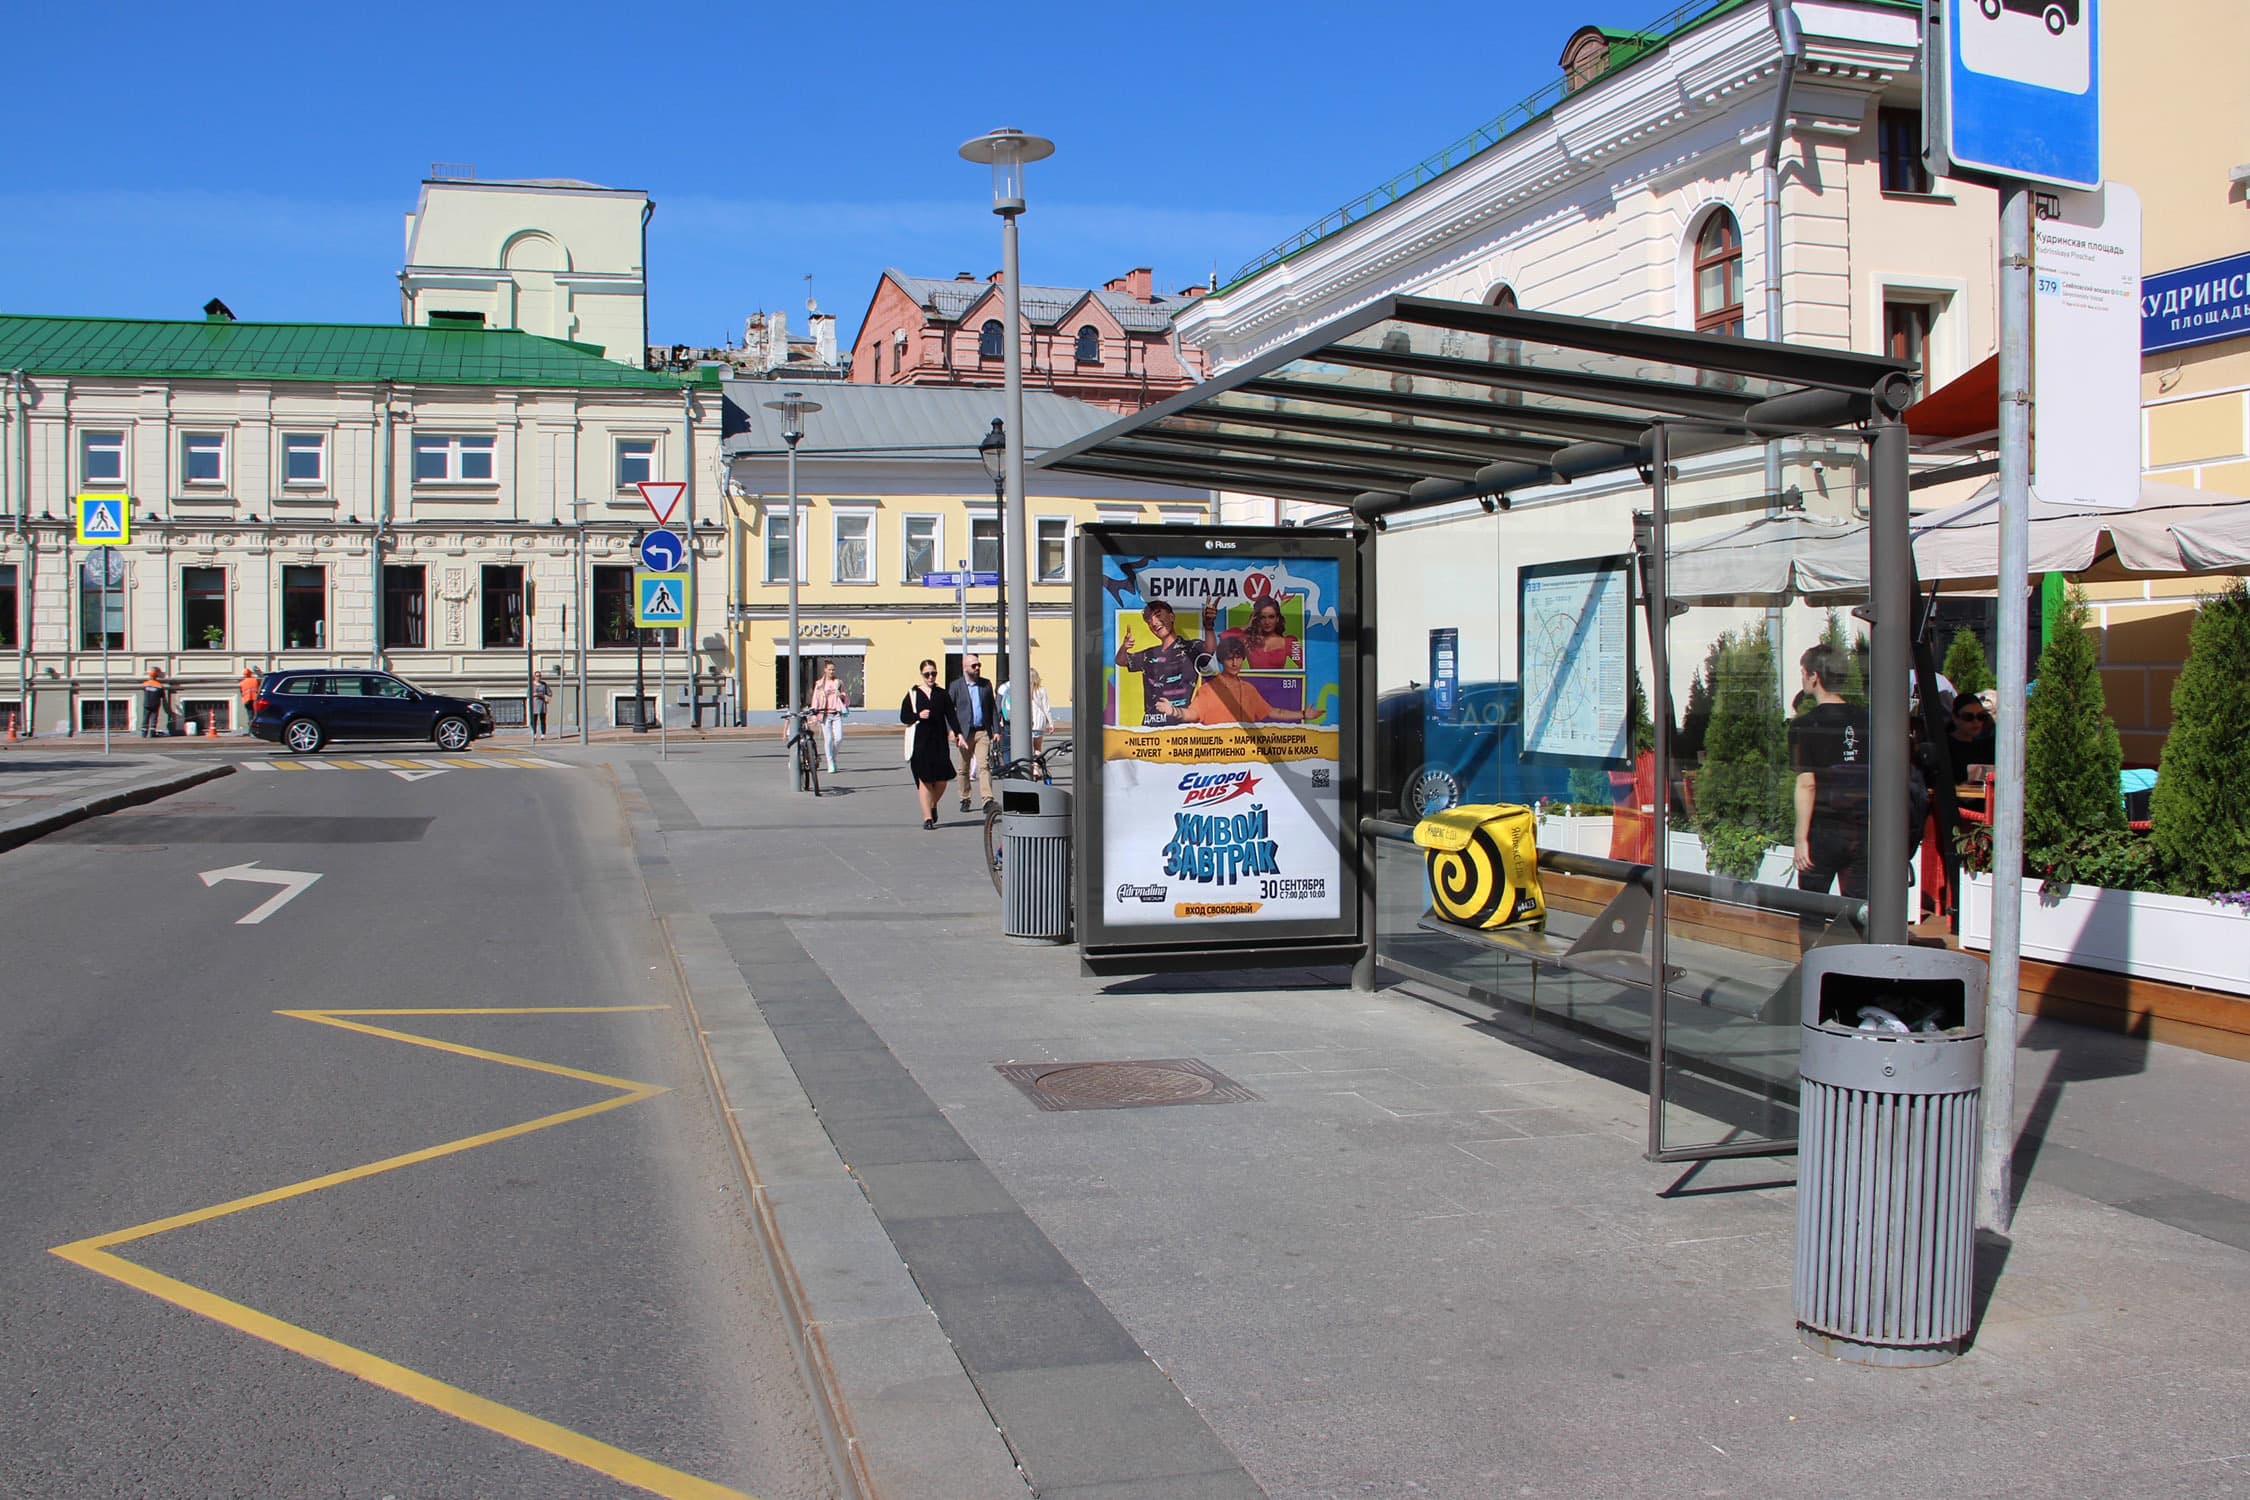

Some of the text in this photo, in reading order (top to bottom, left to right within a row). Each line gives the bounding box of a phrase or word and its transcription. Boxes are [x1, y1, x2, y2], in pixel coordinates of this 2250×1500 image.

[2036, 231, 2124, 256] Кудринская площадь
[2038, 279, 2057, 293] 379
[2171, 303, 2250, 331] ПЛОЩАДЬ
[1215, 540, 1236, 550] Russ
[1150, 577, 1239, 598] БРИГАДА
[798, 621, 850, 639] odega
[1282, 679, 1297, 689] ВЭЛ
[1144, 713, 1167, 725] ДЖЕМ
[1129, 737, 1160, 746] NILETTO
[1171, 736, 1224, 746] МОЯ МИШЕЛЬ
[1234, 733, 1306, 745] МАРИ КРАЙМБРЕРИ
[1136, 749, 1162, 758] ZIVERT
[1173, 748, 1246, 759] ВАНЯ ДМИТРИЕНКО
[1257, 747, 1287, 756] FILATOV
[1294, 746, 1318, 756] KARAS
[1178, 770, 1247, 791] Europa
[1173, 803, 1269, 847] ЖИВОЙ
[1162, 840, 1280, 886] ЗАВТРАК
[1260, 879, 1325, 899] 30 СЕНТЯБРЯ
[1298, 891, 1309, 900] ДО
[1309, 890, 1325, 899] 10:00
[1185, 903, 1253, 916] ВХОД СВОБОДНЫЙ
